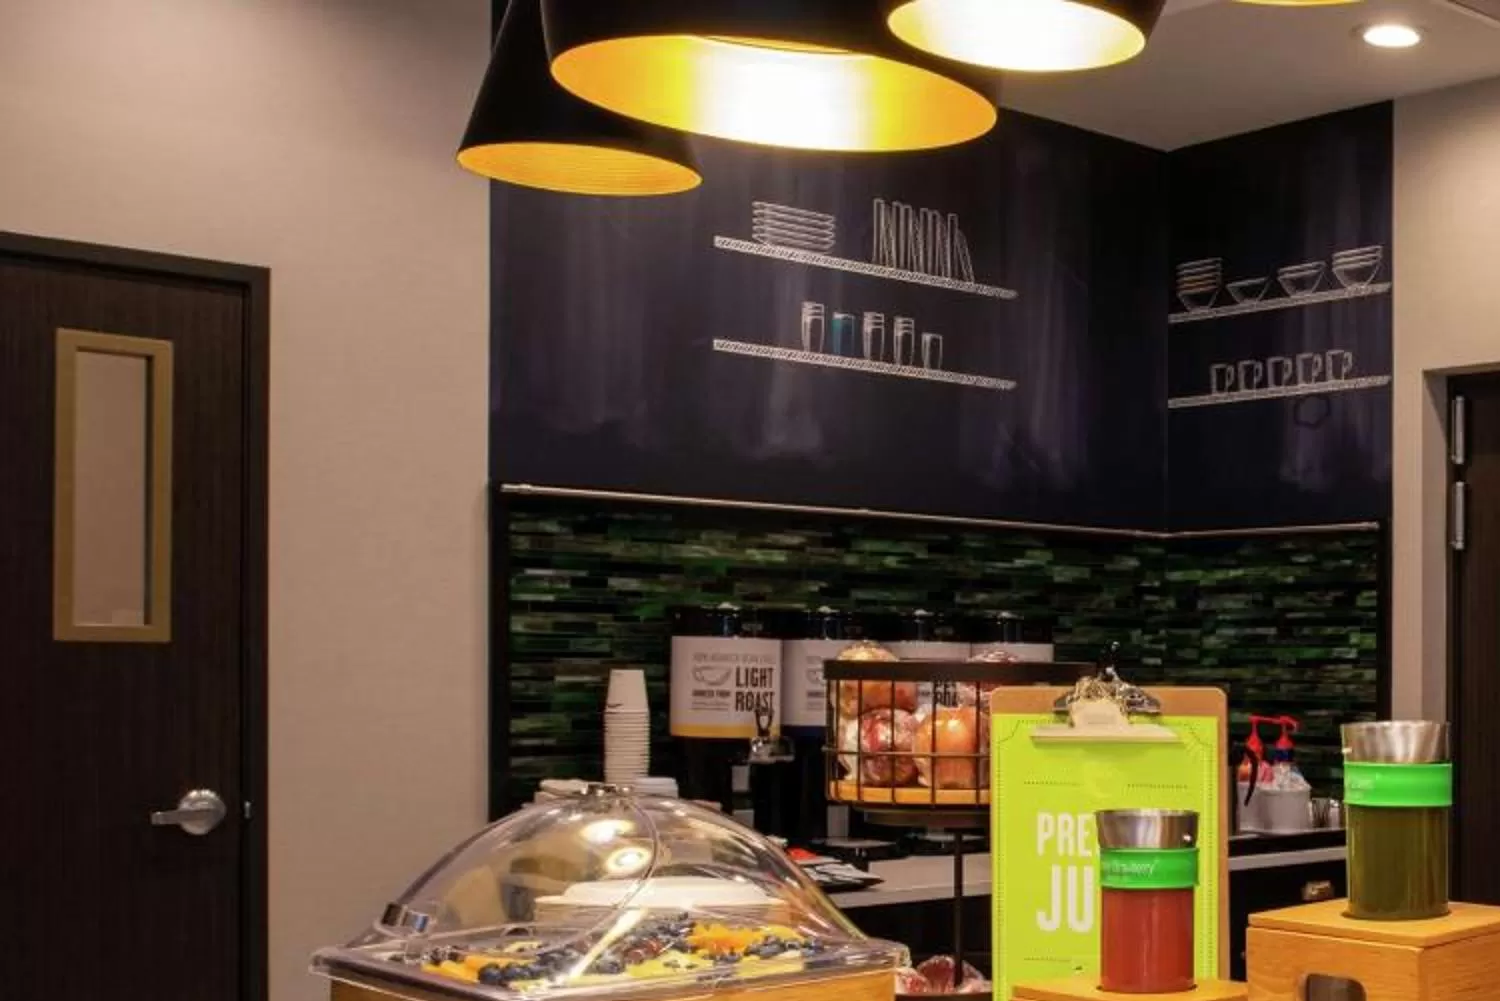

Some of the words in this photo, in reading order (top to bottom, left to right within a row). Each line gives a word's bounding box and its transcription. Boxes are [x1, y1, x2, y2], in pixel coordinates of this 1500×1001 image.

[735, 667, 774, 688] LIGHT
[735, 691, 775, 712] ROAST
[1036, 813, 1098, 856] PRE
[1036, 865, 1094, 933] JU
